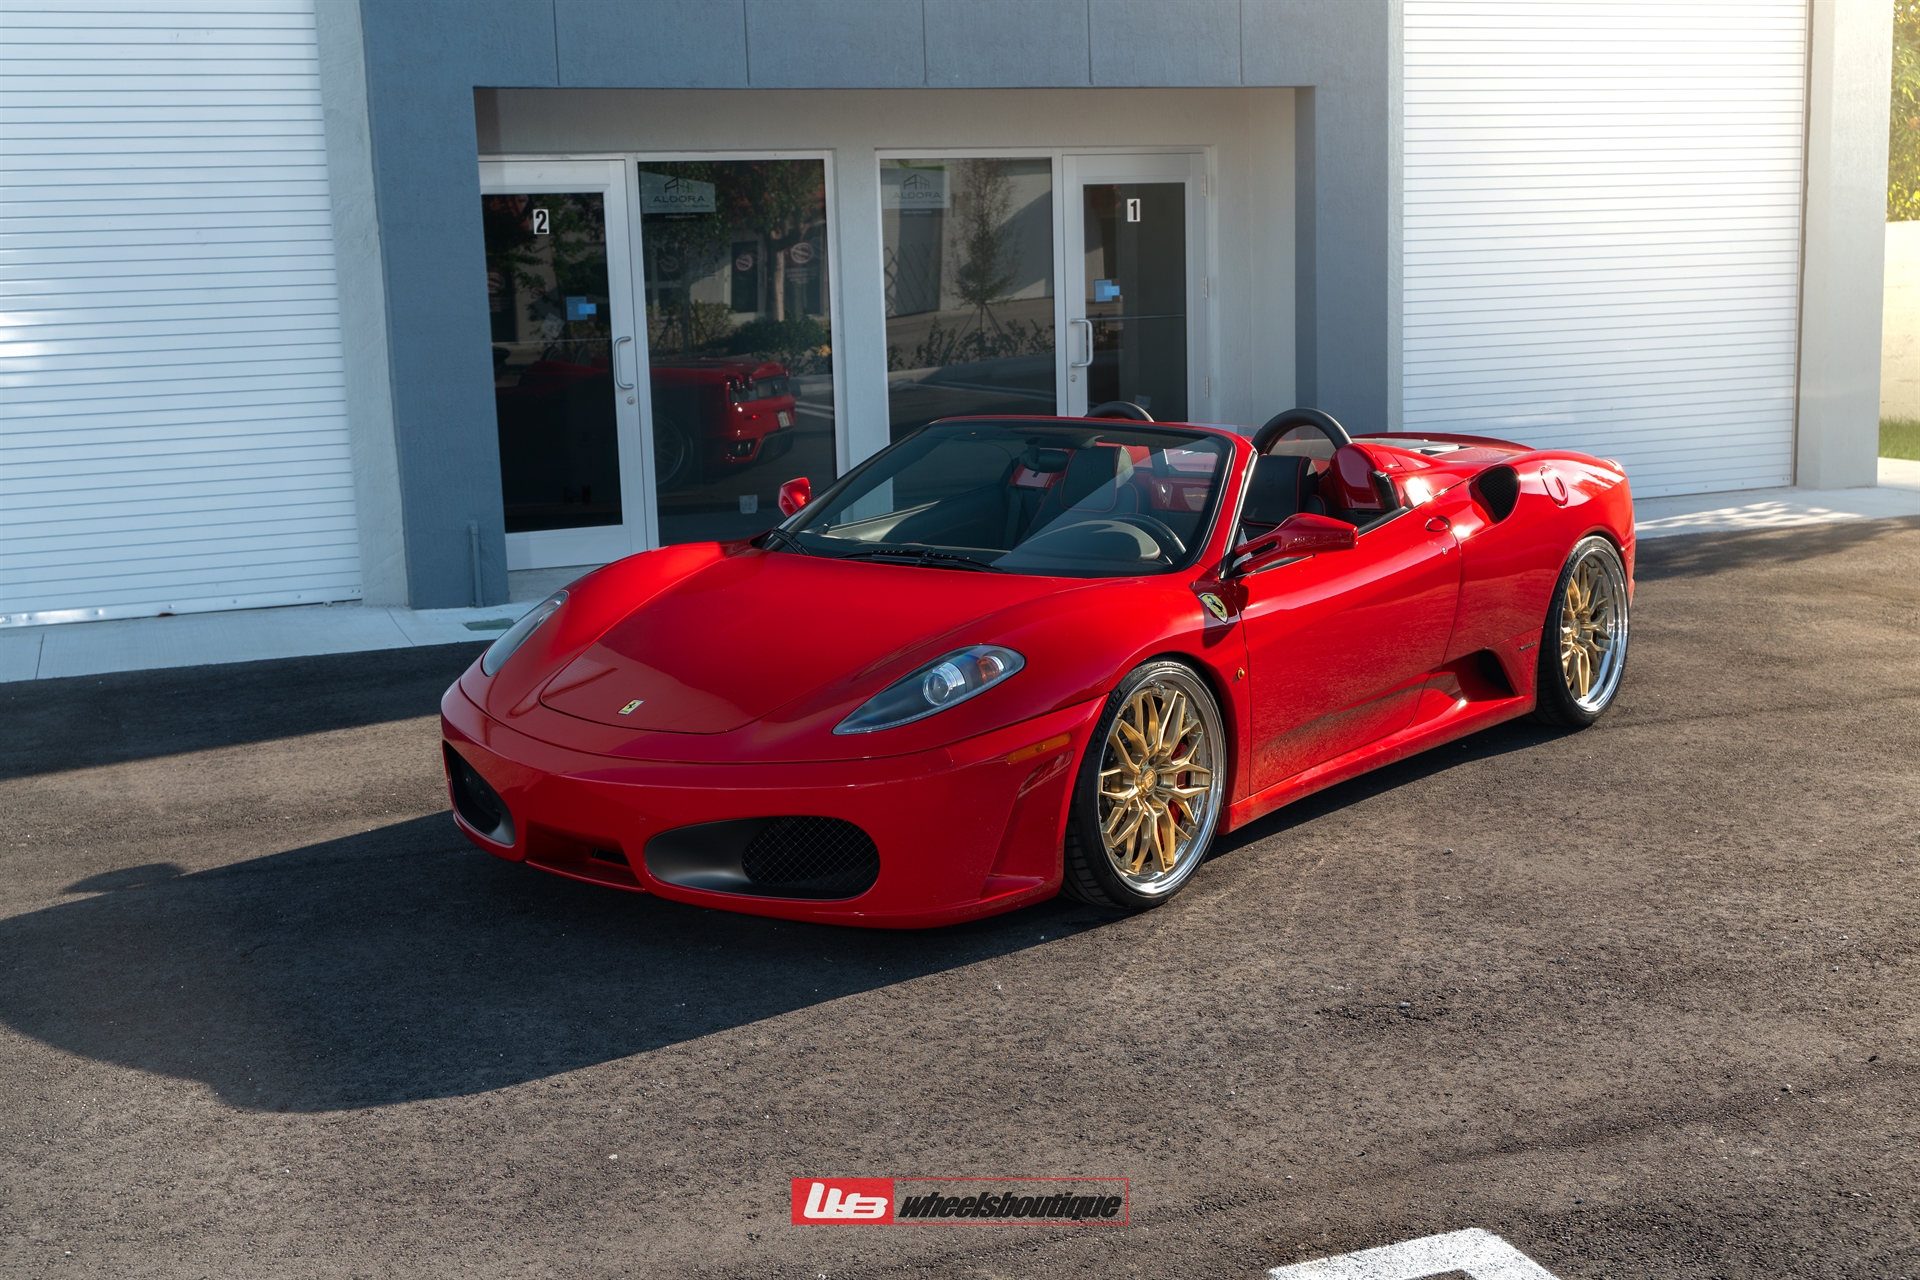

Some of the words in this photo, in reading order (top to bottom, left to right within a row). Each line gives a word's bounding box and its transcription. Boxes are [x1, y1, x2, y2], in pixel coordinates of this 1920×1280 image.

[653, 195, 706, 203] ALDORA
[892, 191, 942, 199] ALDORA
[1130, 200, 1138, 221] 1
[535, 210, 548, 234] 2
